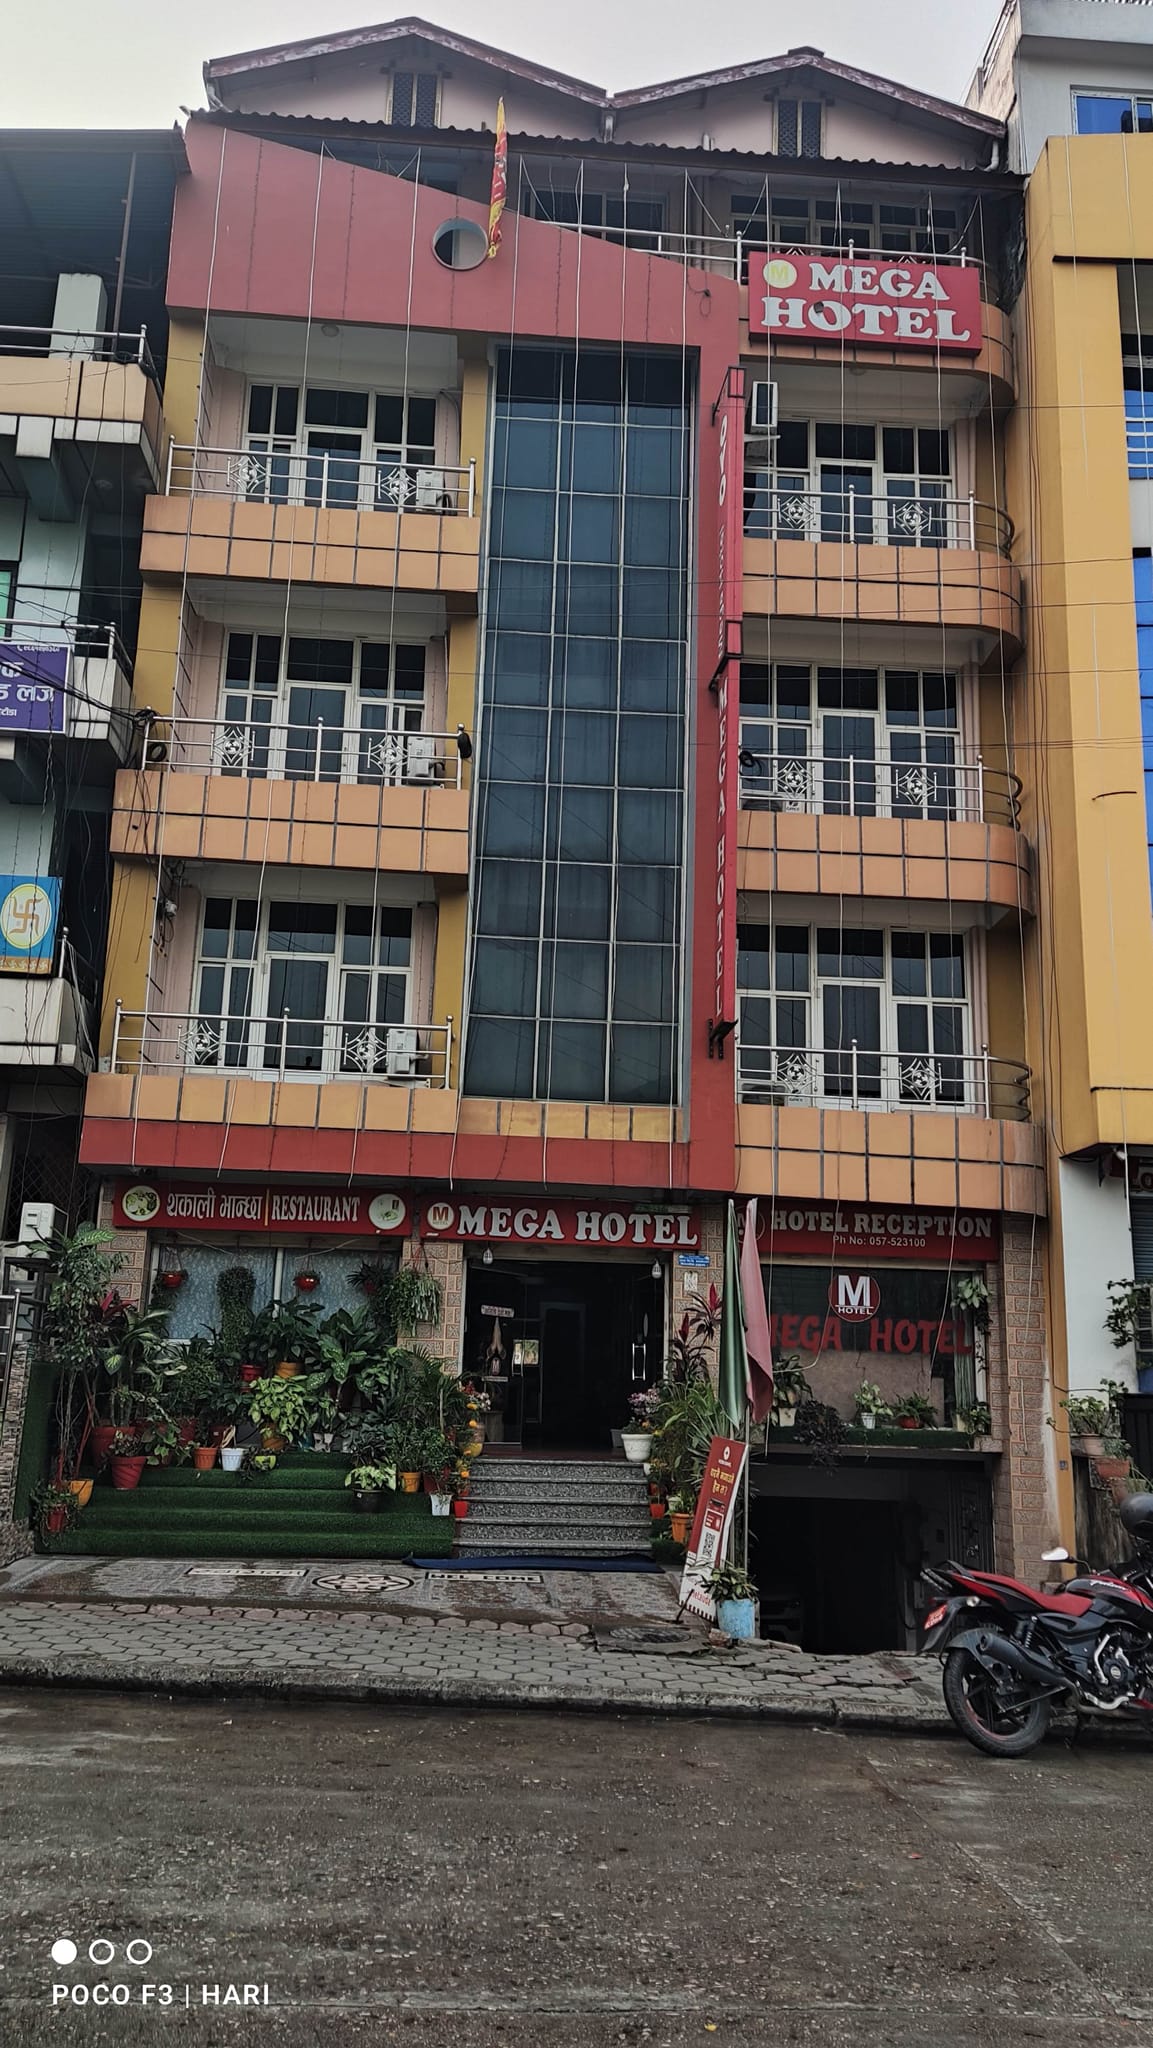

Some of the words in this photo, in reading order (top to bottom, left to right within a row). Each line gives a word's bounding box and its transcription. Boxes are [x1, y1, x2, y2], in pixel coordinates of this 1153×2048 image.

[808, 262, 950, 301] MEGA
[761, 296, 971, 342] HOTEL
[717, 677, 728, 823] MEGA
[716, 834, 726, 1017] HOTEL
[166, 1186, 216, 1219] थकाली
[219, 1195, 263, 1220] भान्छा
[271, 1194, 361, 1222] RESTAURANT
[432, 1206, 449, 1220] M
[456, 1205, 565, 1240] MEGA
[575, 1211, 698, 1245] HOTEL
[771, 1210, 848, 1233] HOTEL
[854, 1213, 992, 1238] RECEPTION
[832, 1235, 846, 1244] Ph
[849, 1236, 866, 1245] No:
[869, 1236, 926, 1247] 057-523100
[838, 1274, 871, 1306] M
[838, 1307, 873, 1315] HOTEL
[870, 1317, 972, 1354] HOTEL
